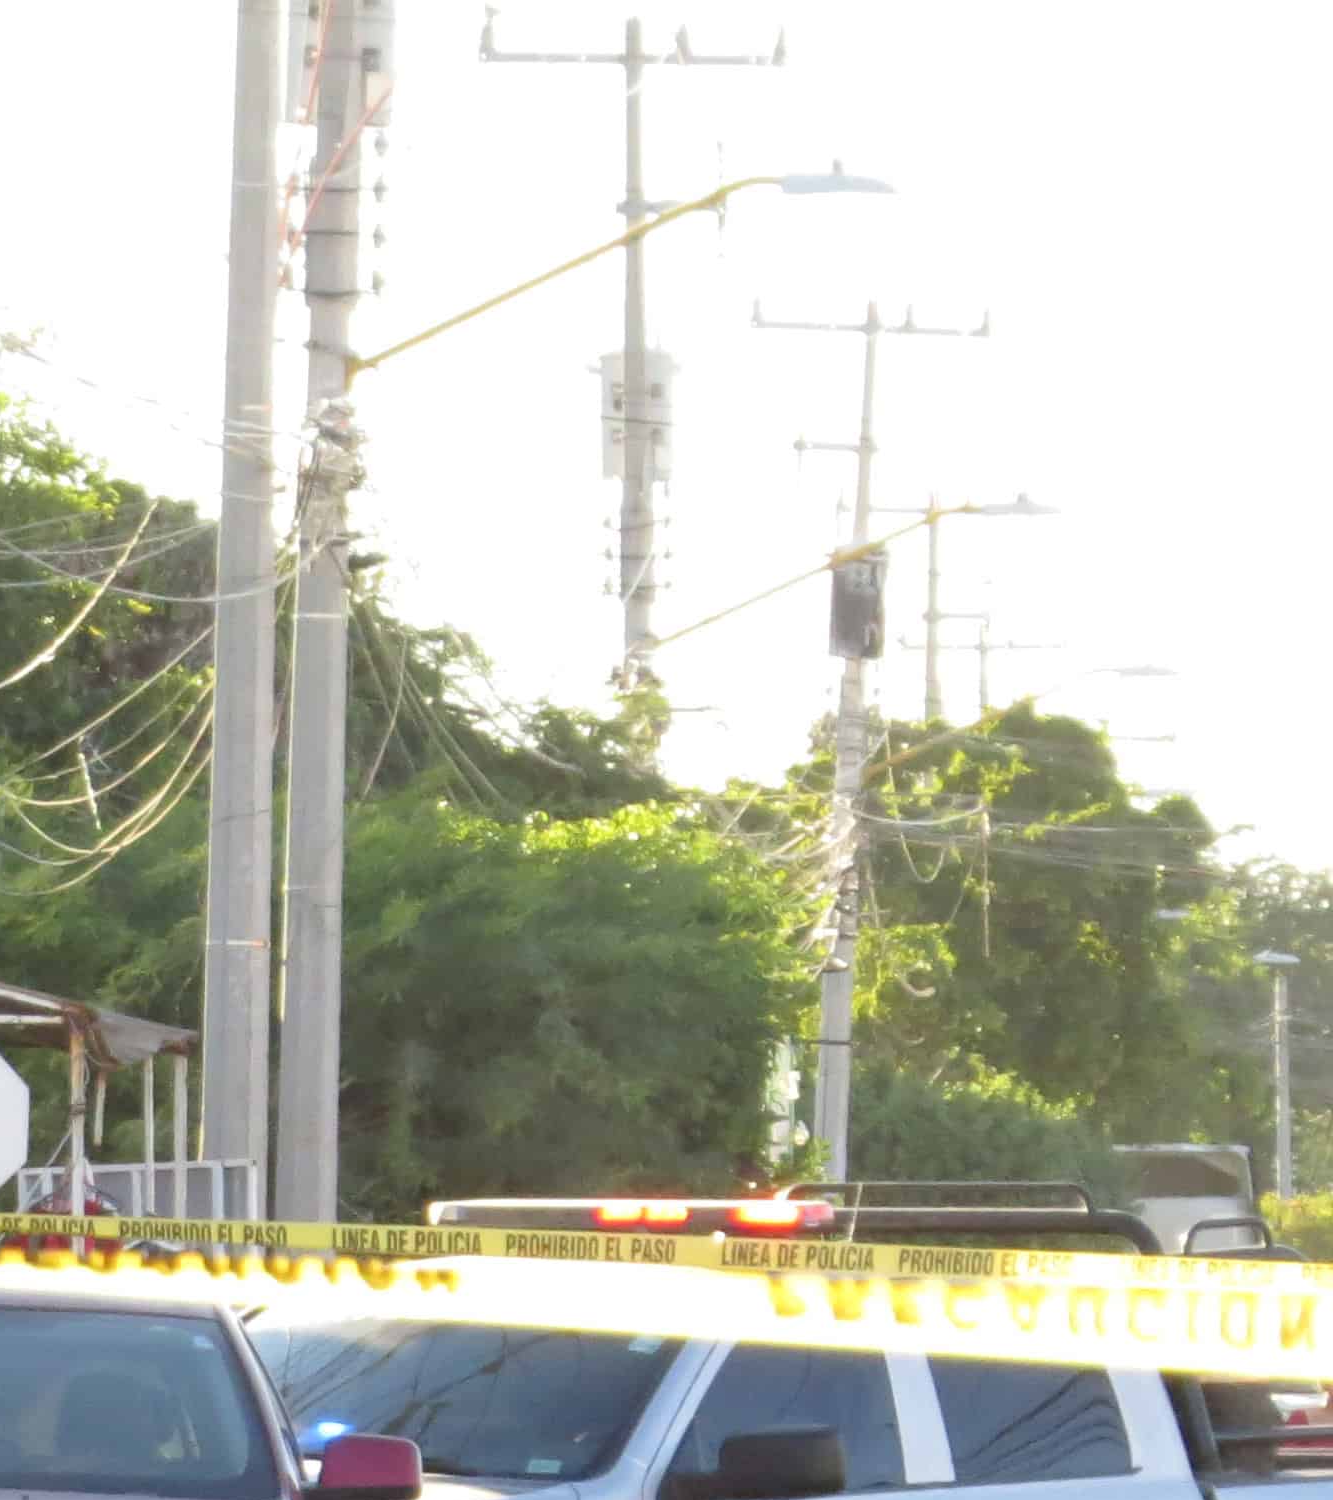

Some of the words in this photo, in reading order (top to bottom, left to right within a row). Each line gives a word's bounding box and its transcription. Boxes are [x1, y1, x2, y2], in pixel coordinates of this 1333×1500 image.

[30, 1218, 95, 1235] POLICIA
[118, 1221, 212, 1243] PROHIBIDO
[217, 1224, 233, 1244] EL
[243, 1224, 287, 1247] PASO
[332, 1227, 380, 1251] LINEA
[387, 1229, 409, 1253] DE
[414, 1231, 482, 1255] POLICIA
[504, 1233, 599, 1260] PROHIBIDO
[604, 1236, 623, 1261] EL
[629, 1238, 676, 1264] PASO
[721, 1240, 772, 1267] LINEA
[776, 1243, 800, 1269] DE
[805, 1245, 875, 1272] POLICIA
[898, 1248, 994, 1277] PROHIBIDO
[999, 1252, 1018, 1278] EL
